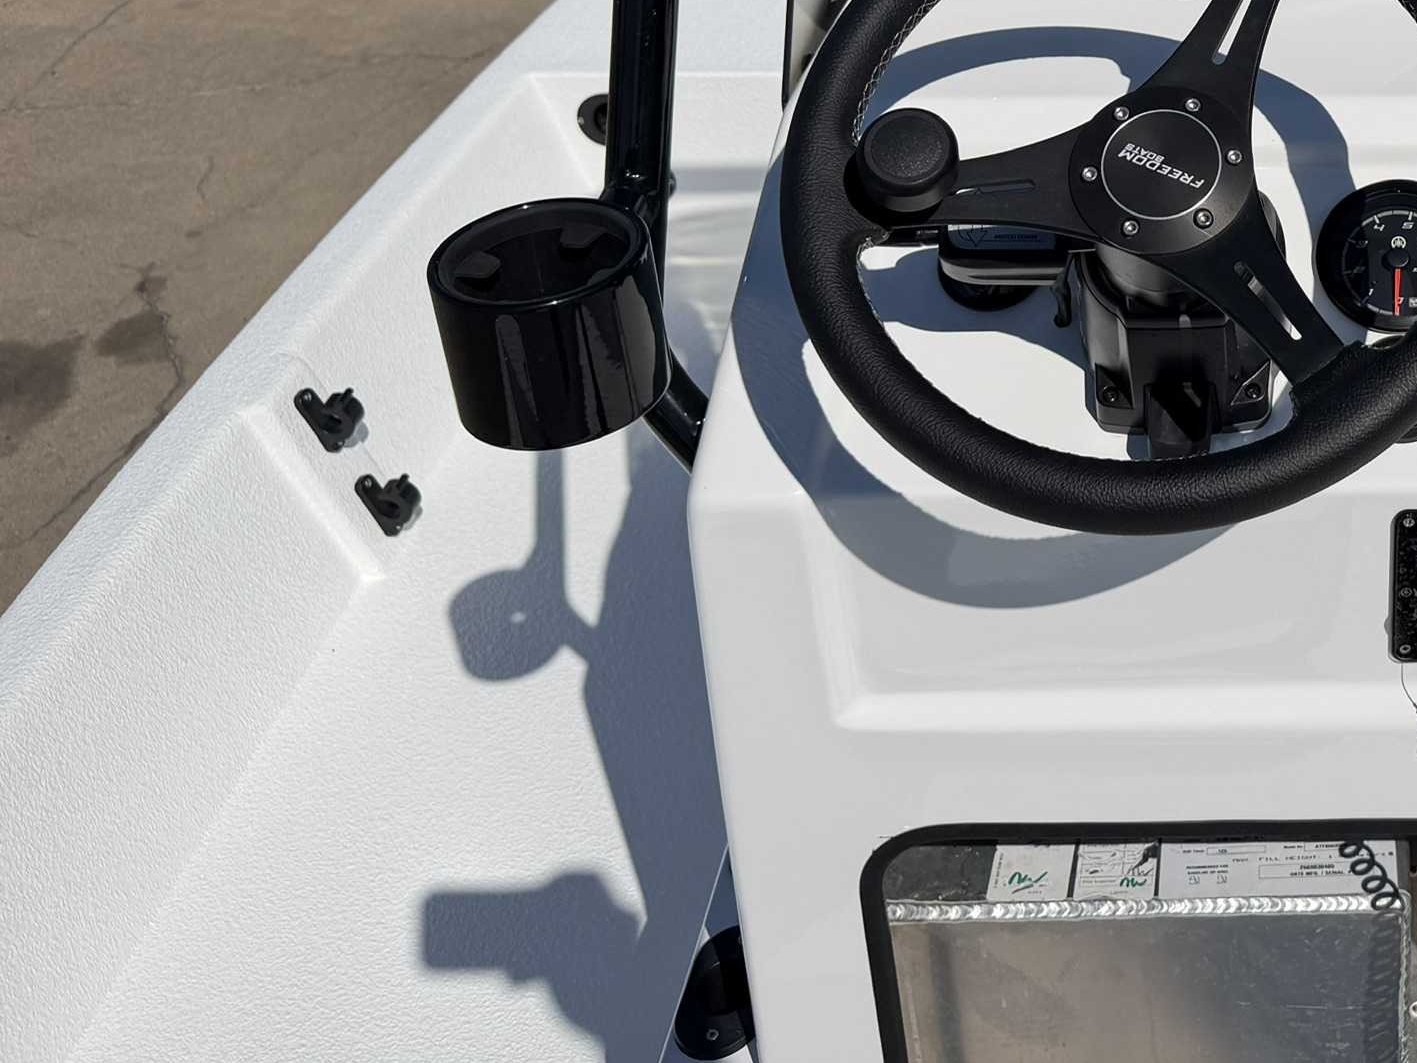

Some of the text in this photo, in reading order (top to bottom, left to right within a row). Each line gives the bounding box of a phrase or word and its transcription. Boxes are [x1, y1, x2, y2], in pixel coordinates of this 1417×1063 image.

[1124, 143, 1165, 163] BOATS
[1117, 149, 1205, 189] FREEDOM
[1373, 223, 1385, 233] 4
[1401, 221, 1414, 230] 5
